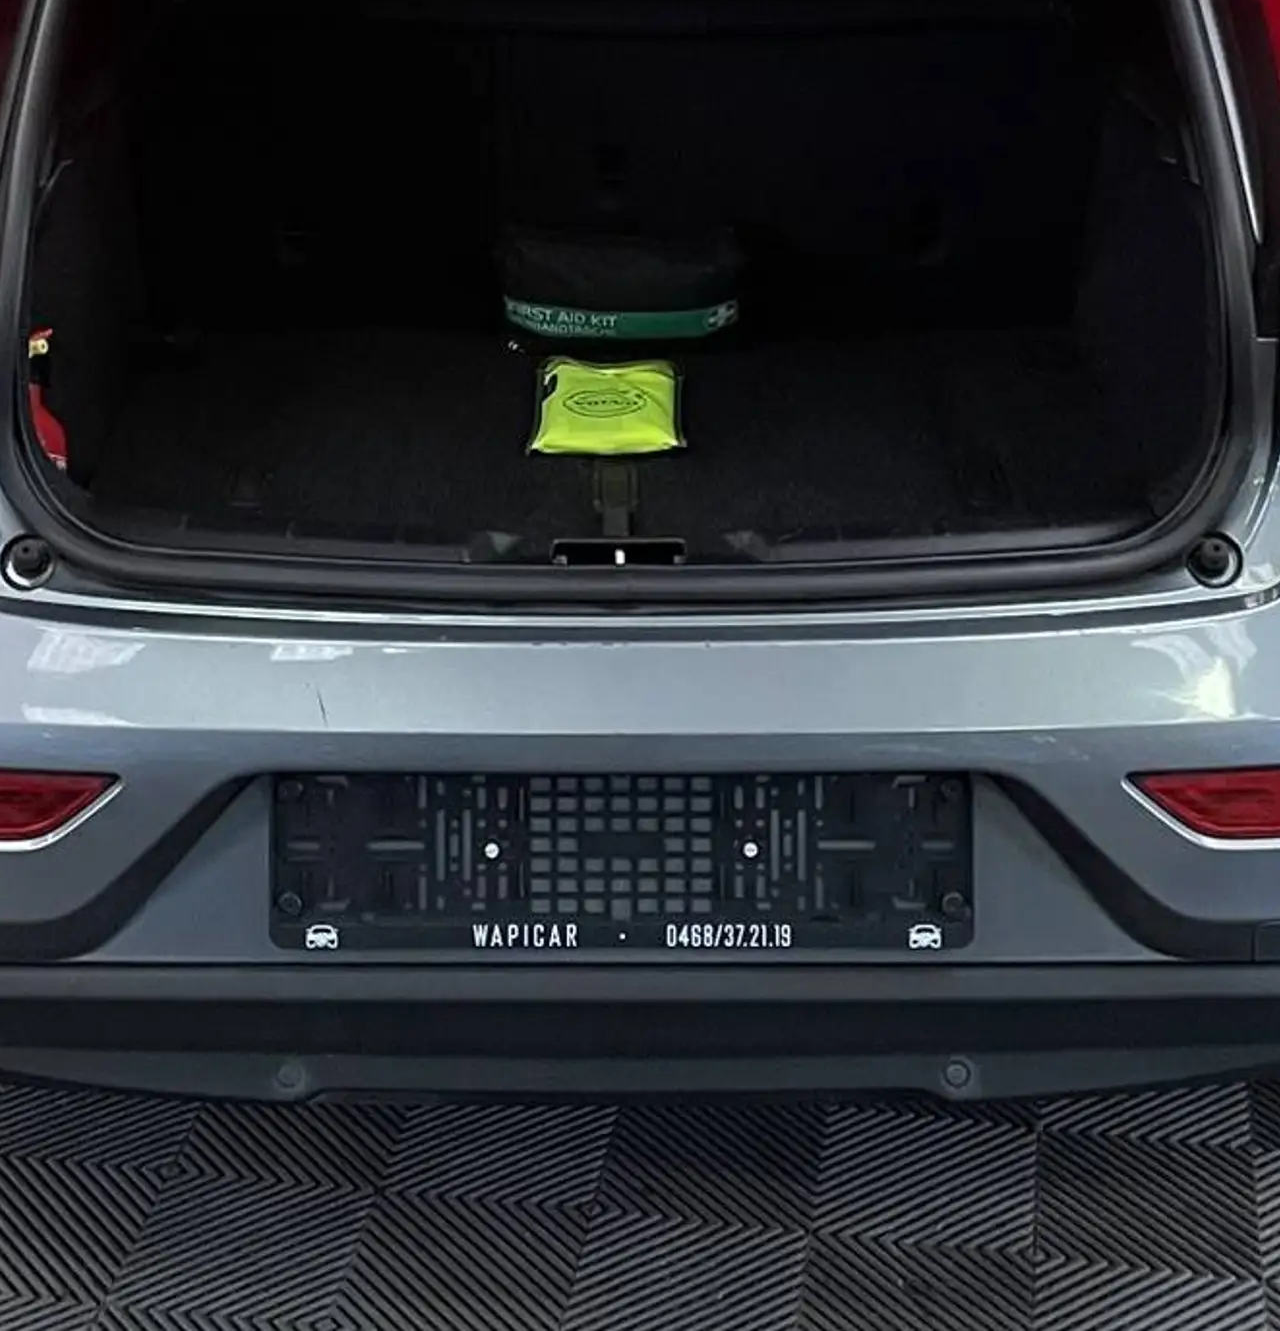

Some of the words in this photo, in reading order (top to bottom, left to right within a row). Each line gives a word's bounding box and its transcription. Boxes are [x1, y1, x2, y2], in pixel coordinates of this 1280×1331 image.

[557, 310, 586, 325] AID
[590, 313, 618, 328] KIT
[472, 923, 578, 948] WAPICAR
[665, 923, 792, 948] 0468/37.21.19
